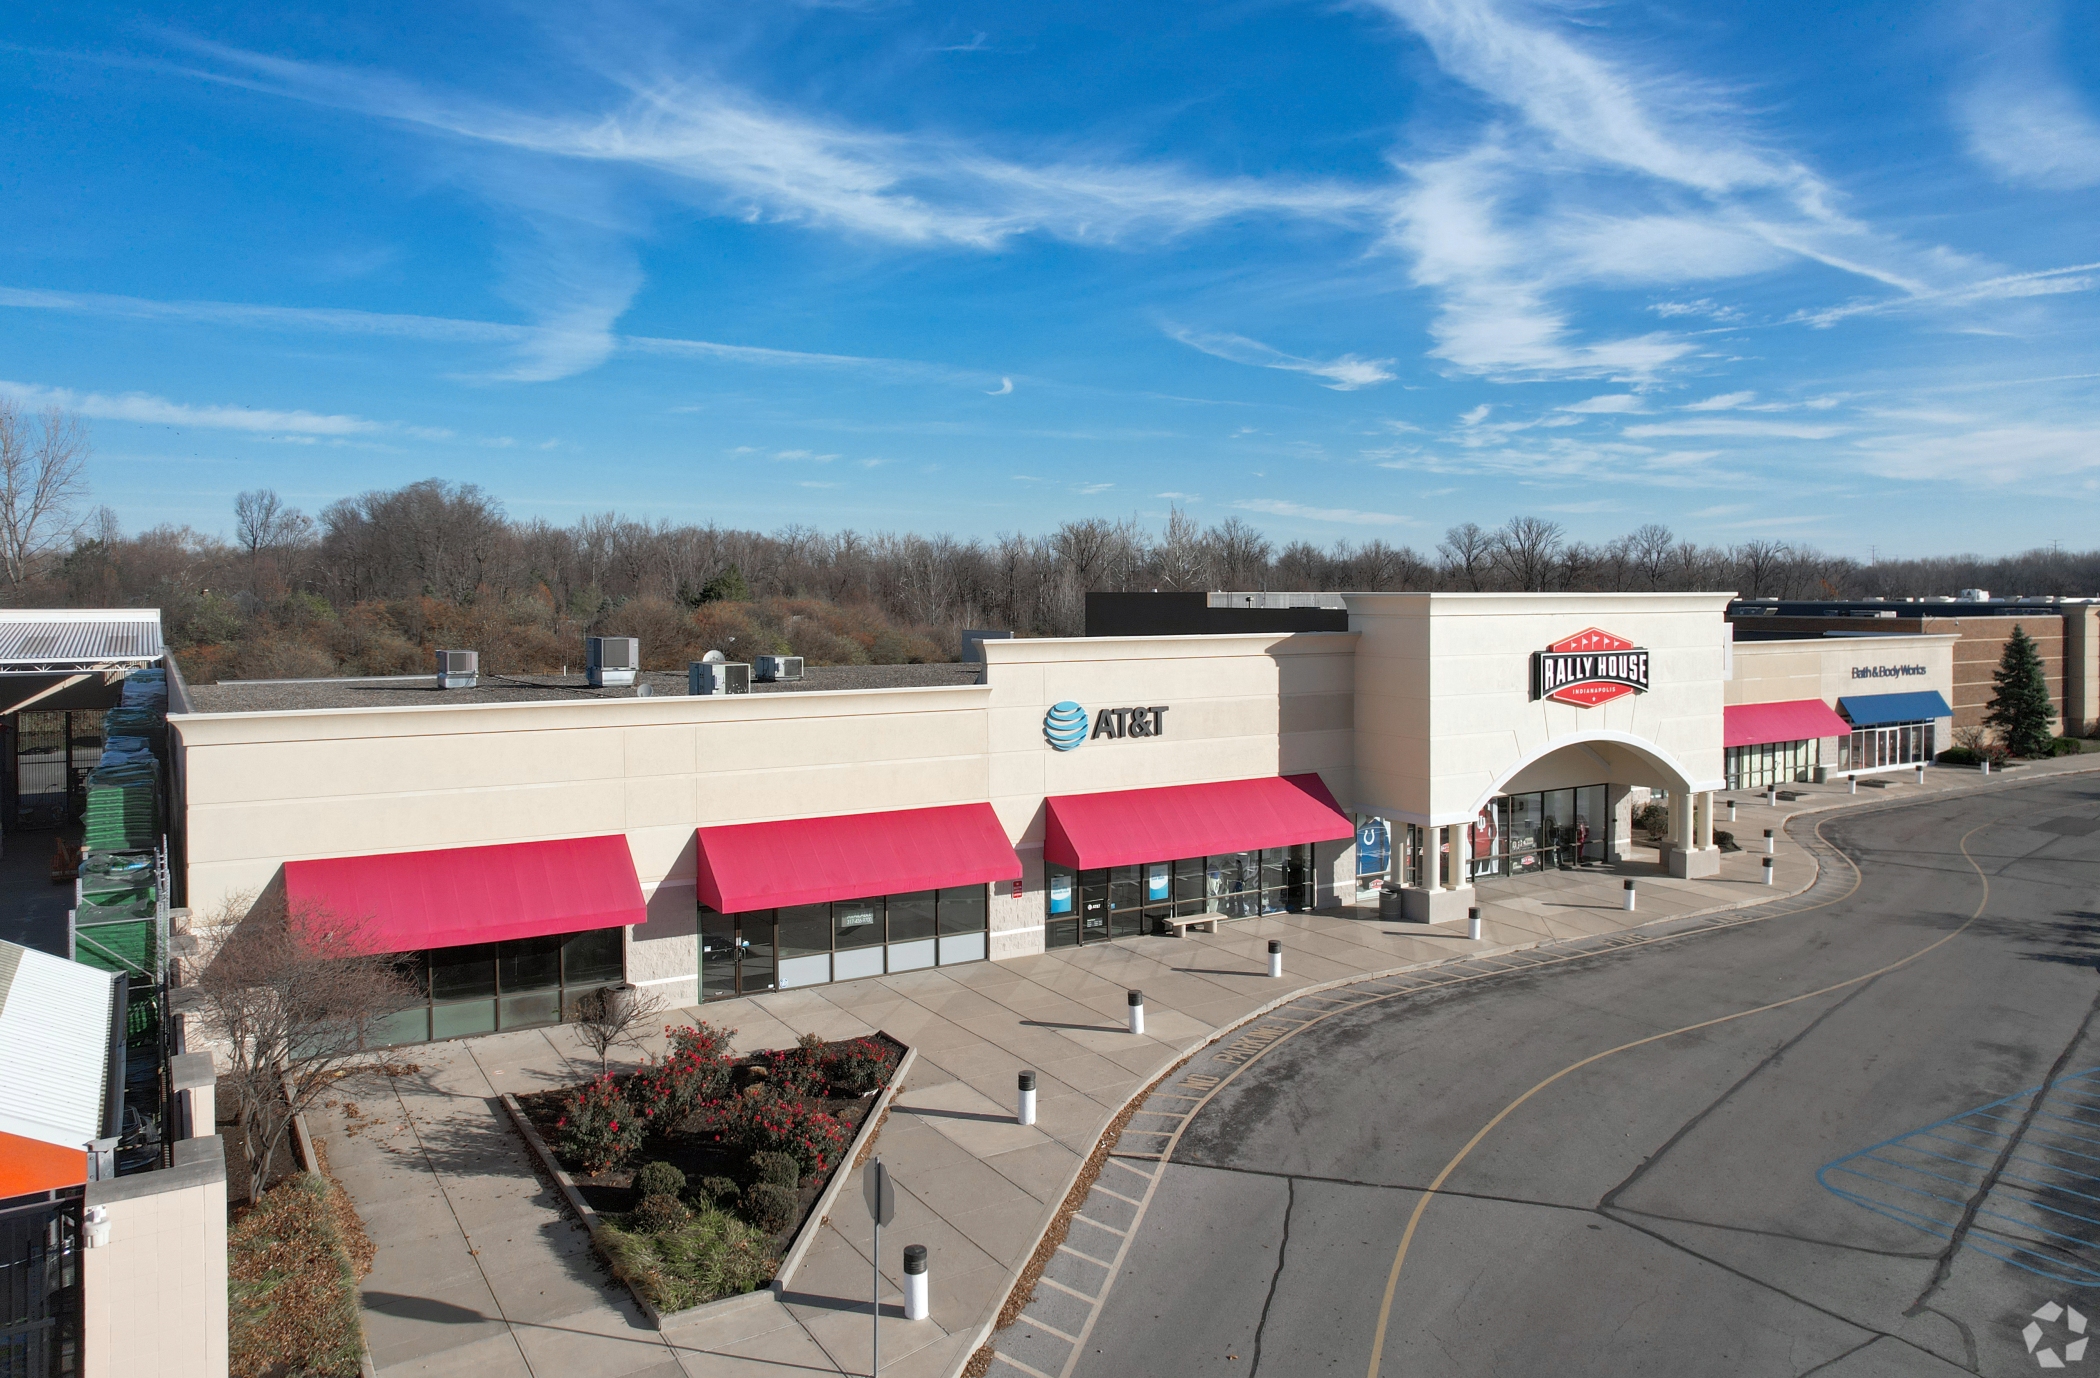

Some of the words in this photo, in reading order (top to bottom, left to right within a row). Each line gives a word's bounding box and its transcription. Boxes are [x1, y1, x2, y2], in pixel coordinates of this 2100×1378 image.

[1544, 656, 1593, 691] RALLY
[1597, 654, 1648, 685] HOUSE
[1851, 666, 1871, 679] Bath
[1872, 666, 1878, 678] &
[1879, 665, 1901, 679] Body
[1900, 664, 1926, 676] Works
[1572, 686, 1616, 695] INDIANAPOLIS
[1091, 705, 1169, 740] AT&T
[1598, 932, 1652, 948] FIRE
[1177, 1073, 1221, 1091] NO
[1212, 1025, 1291, 1065] PARKING
